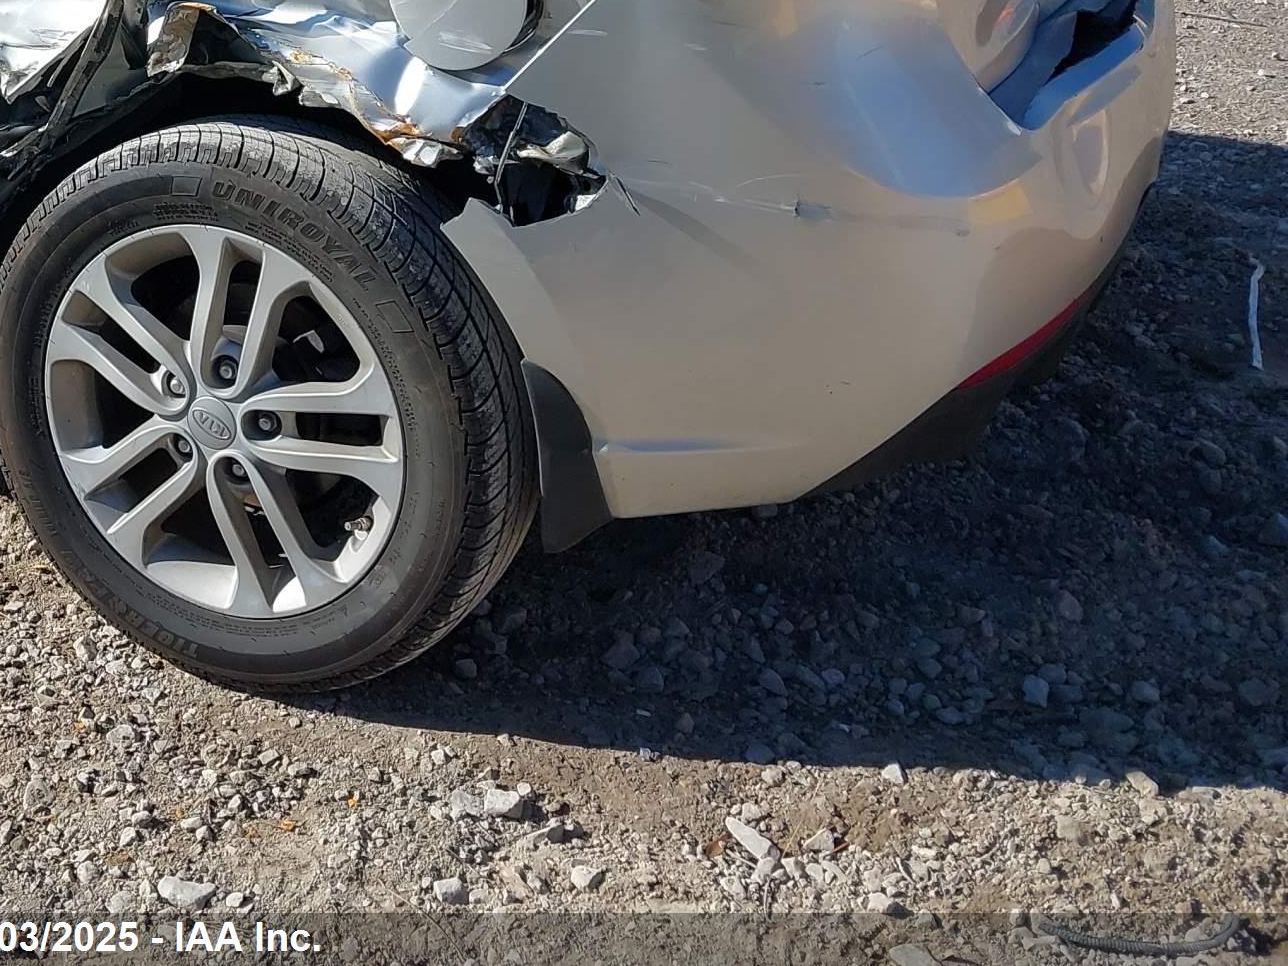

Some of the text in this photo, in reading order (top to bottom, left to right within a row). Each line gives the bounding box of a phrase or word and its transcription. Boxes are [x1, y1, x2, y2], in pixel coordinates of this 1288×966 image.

[211, 178, 377, 291] UNIROYAL
[196, 410, 230, 437] KIA
[124, 611, 200, 658] TIGER
